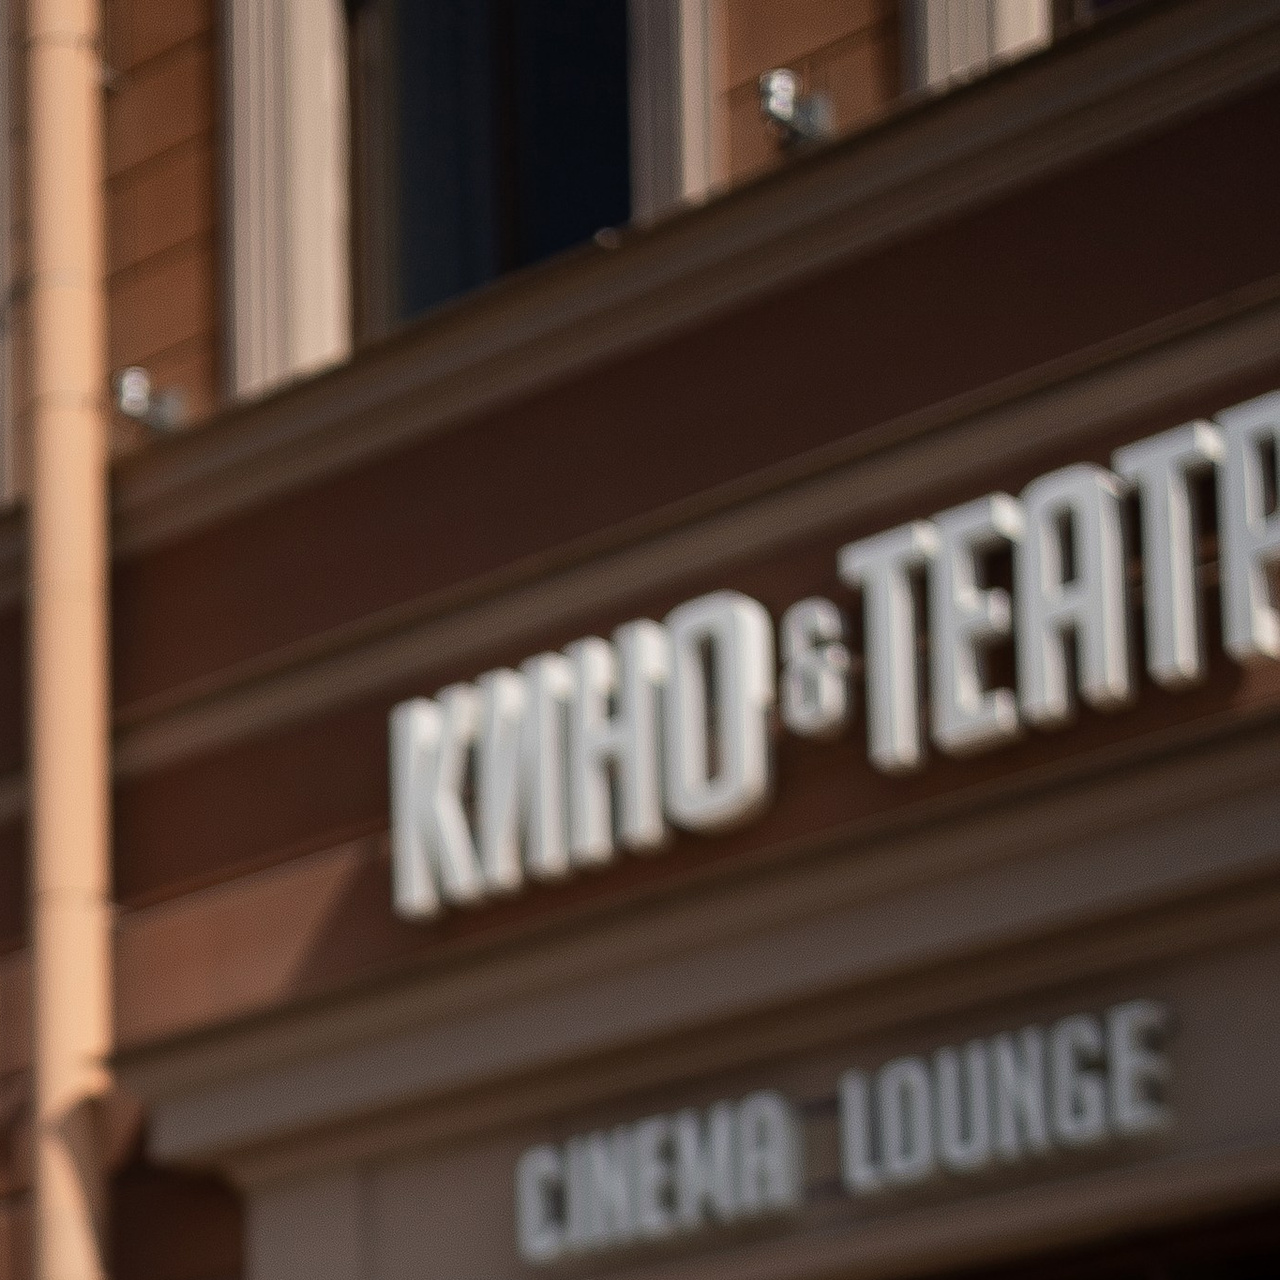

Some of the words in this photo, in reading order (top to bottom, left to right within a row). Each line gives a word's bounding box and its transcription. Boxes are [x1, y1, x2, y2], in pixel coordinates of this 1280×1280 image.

[389, 590, 775, 921] КИНО
[779, 596, 851, 736] &
[517, 1089, 802, 1262] CINEMA
[838, 1000, 1166, 1192] LOUNGE
